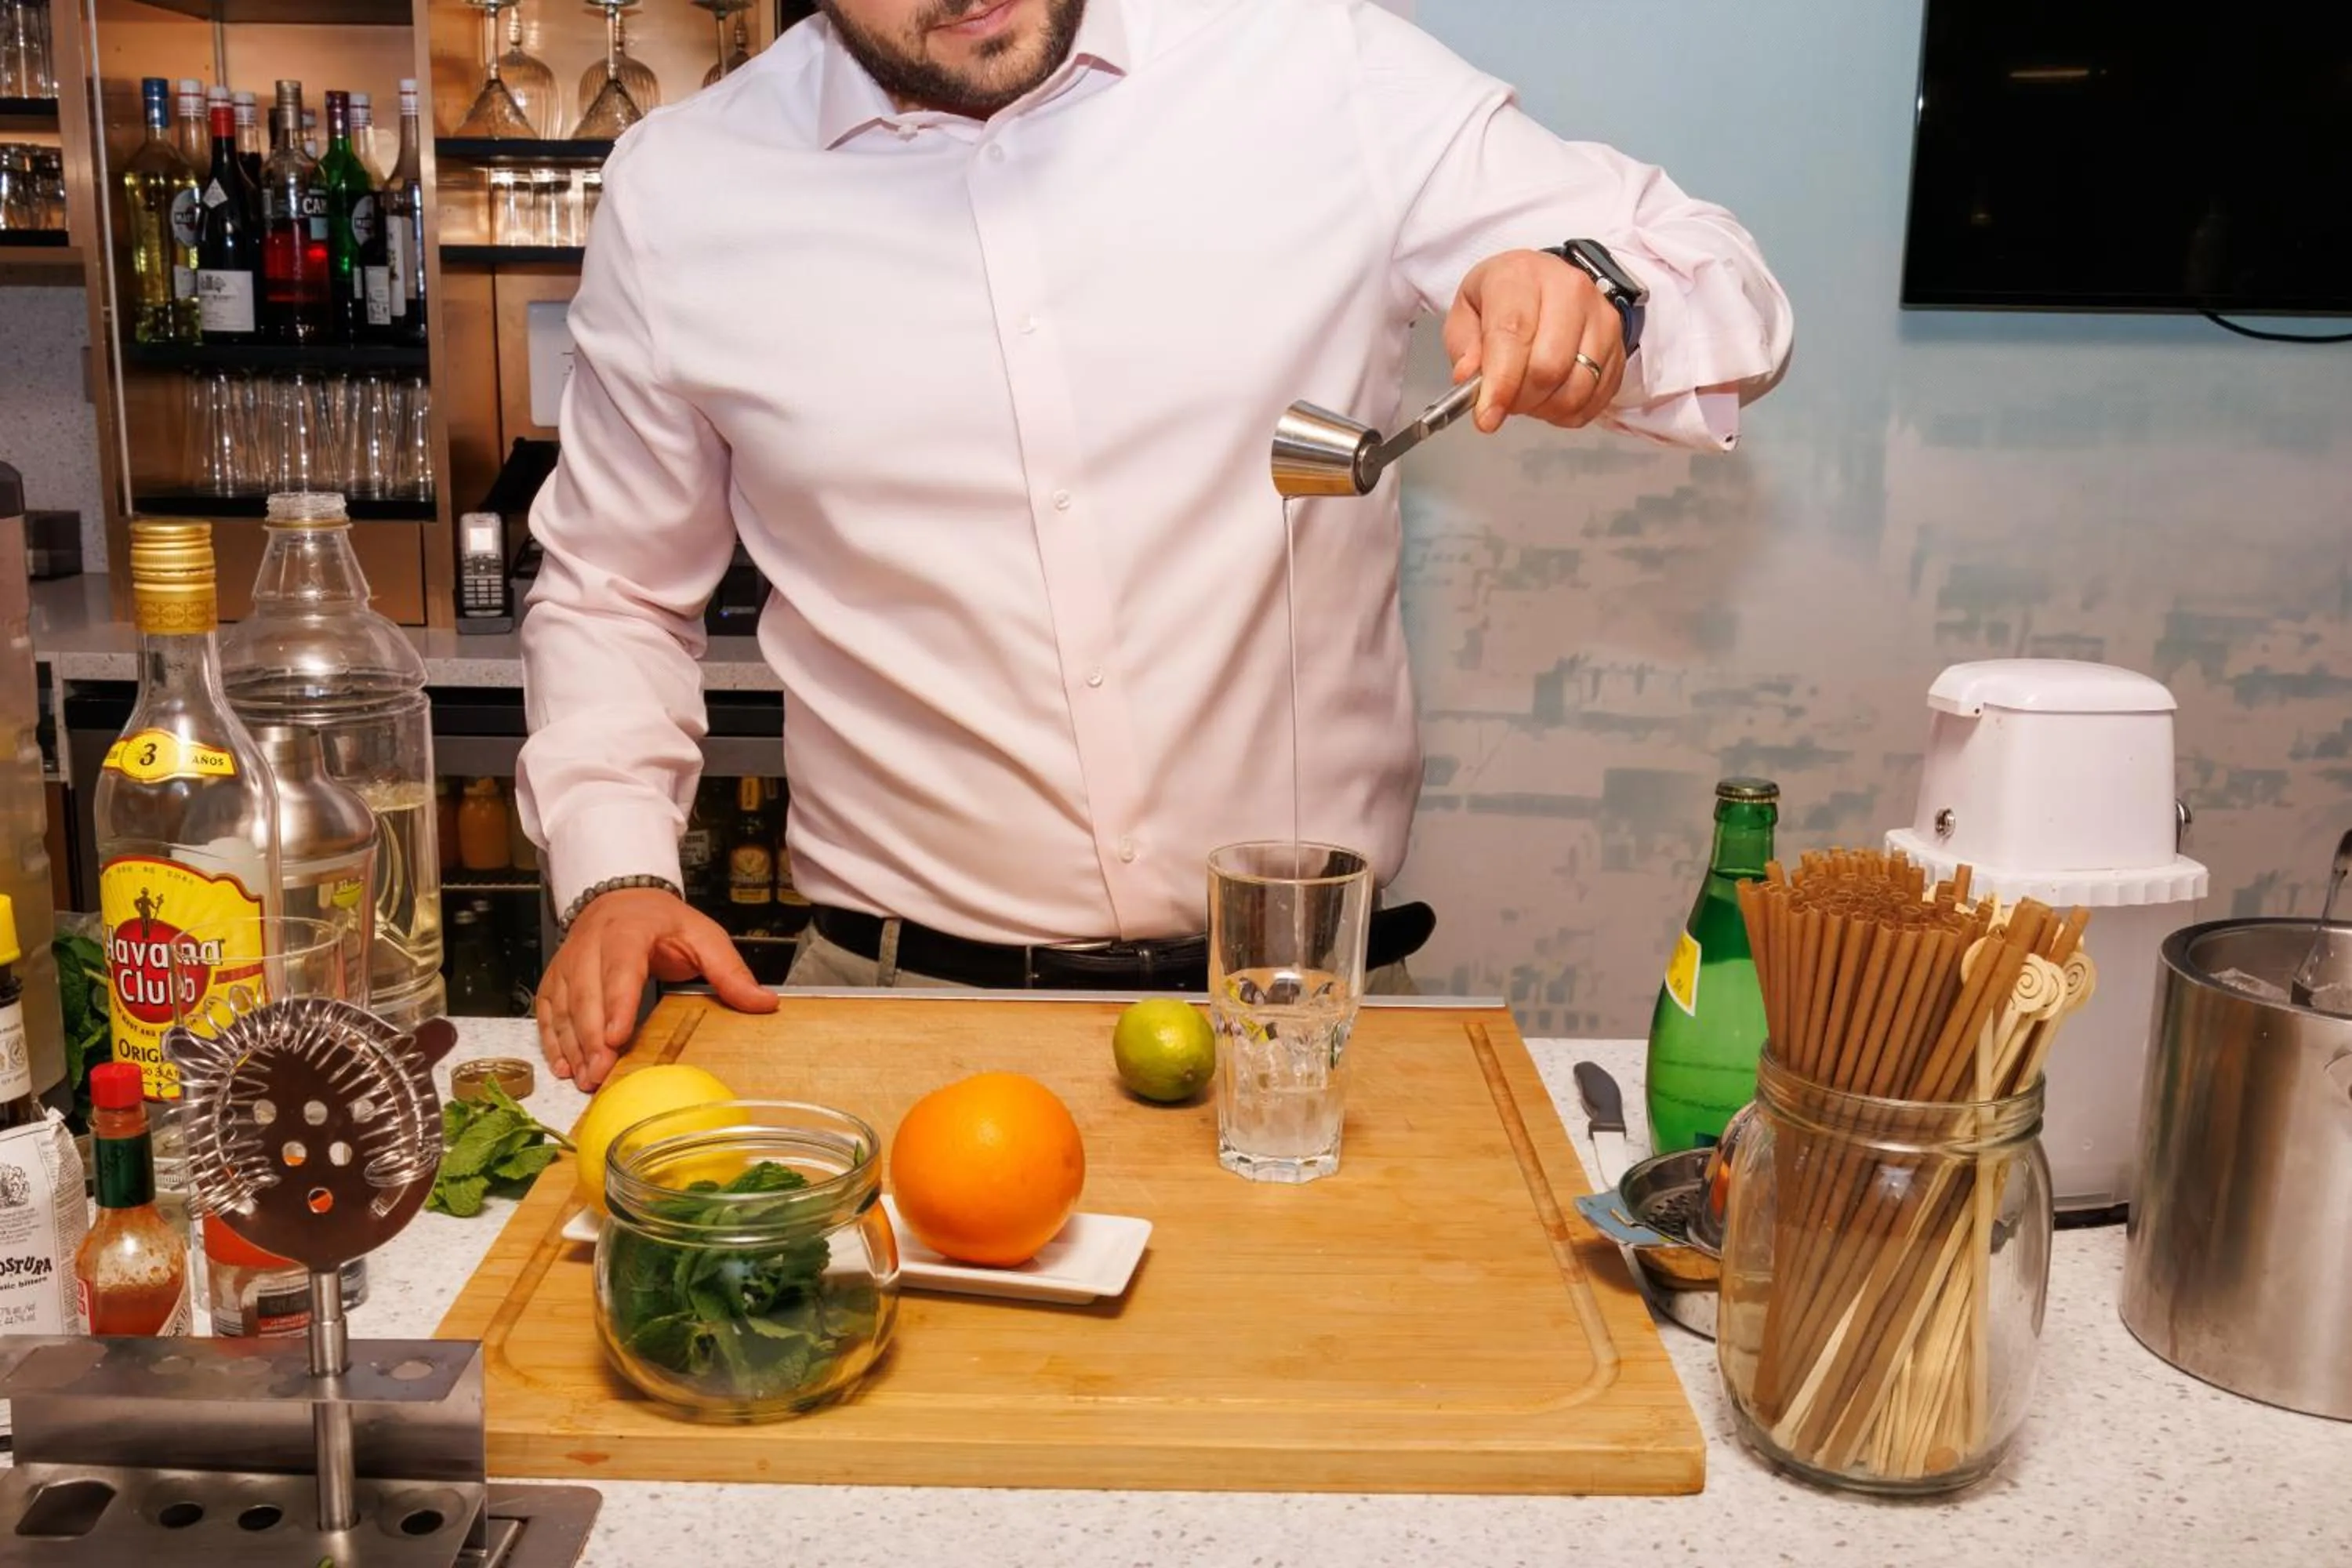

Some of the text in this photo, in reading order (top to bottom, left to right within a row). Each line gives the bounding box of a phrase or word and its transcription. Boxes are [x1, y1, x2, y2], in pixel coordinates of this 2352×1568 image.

[140, 743, 224, 766] 3 AÑOS
[119, 968, 195, 1005] Club
[118, 1038, 165, 1063] ORIG
